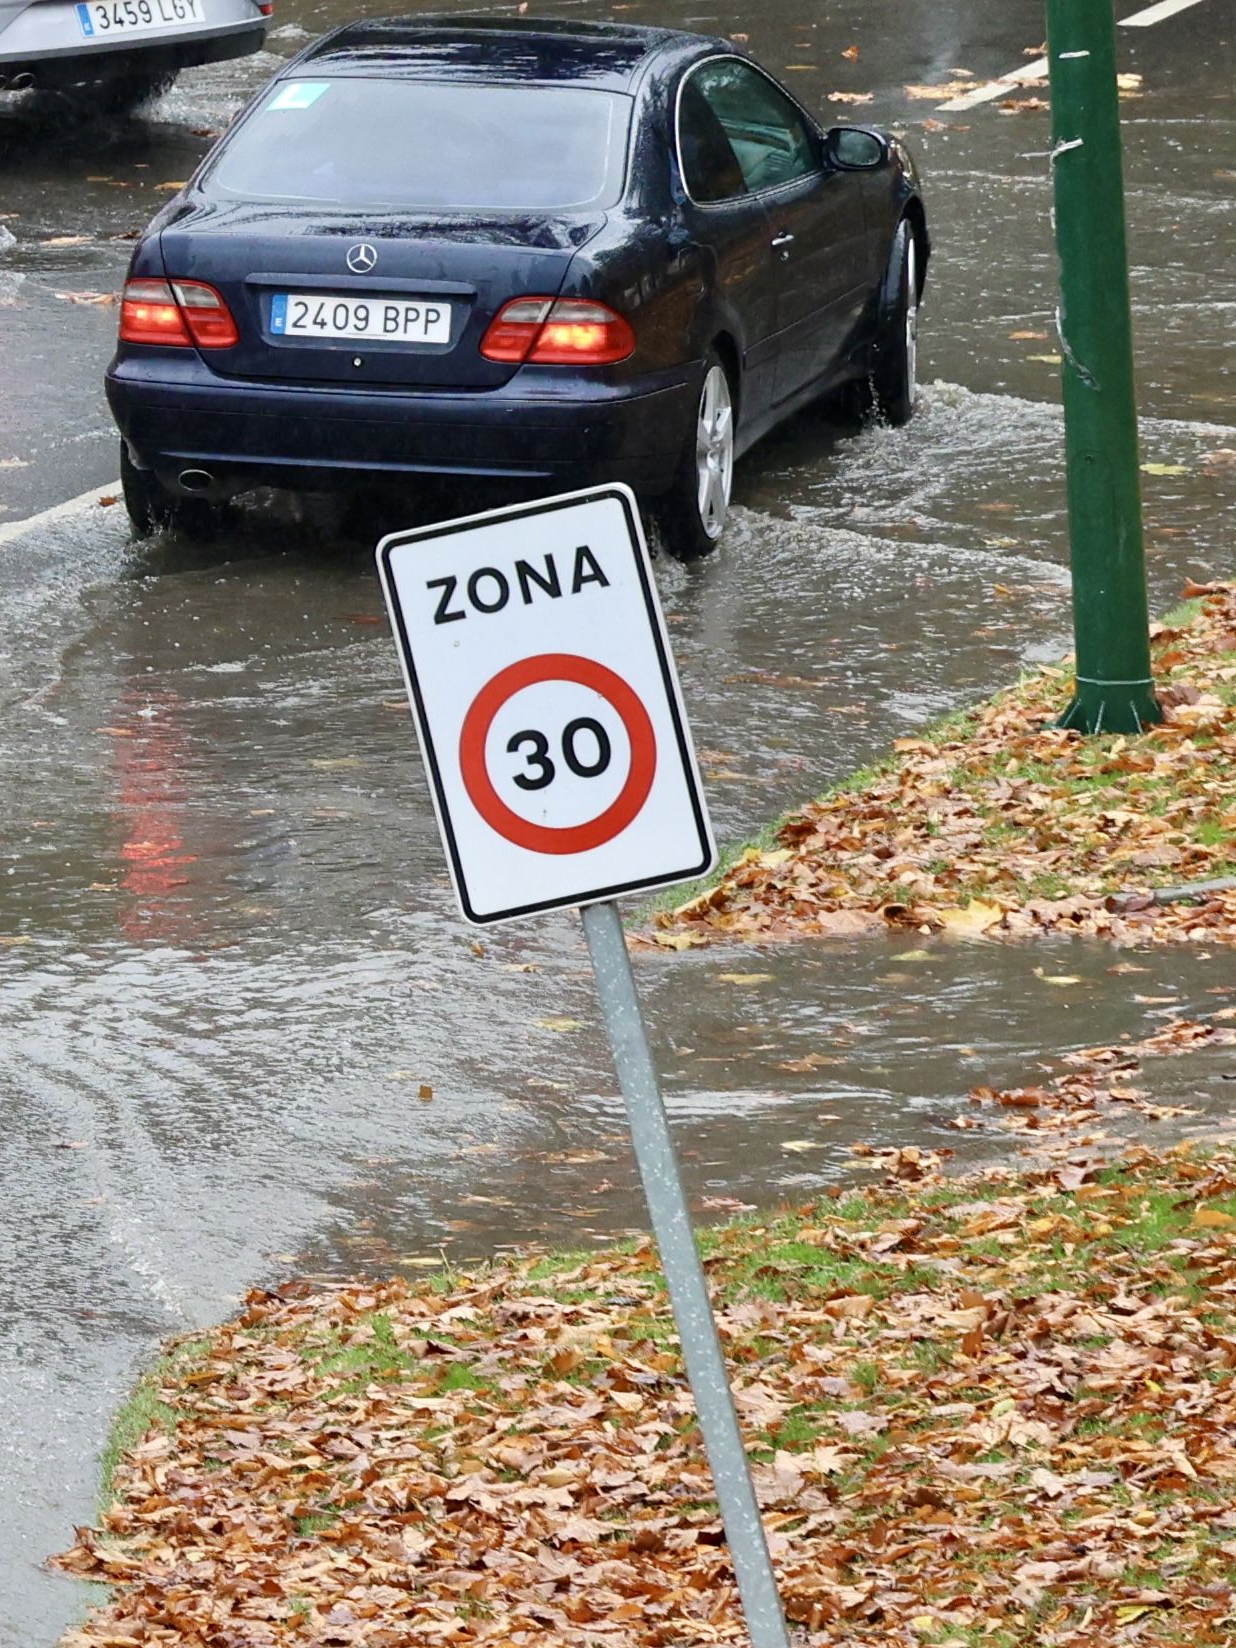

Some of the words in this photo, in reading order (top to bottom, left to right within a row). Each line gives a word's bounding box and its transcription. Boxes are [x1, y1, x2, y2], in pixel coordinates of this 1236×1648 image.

[95, 0, 153, 29] 3459
[157, 0, 197, 22] LGY
[291, 301, 370, 332] 2409
[382, 305, 441, 335] BPP
[426, 545, 610, 625] ZONA
[506, 716, 612, 792] 30
